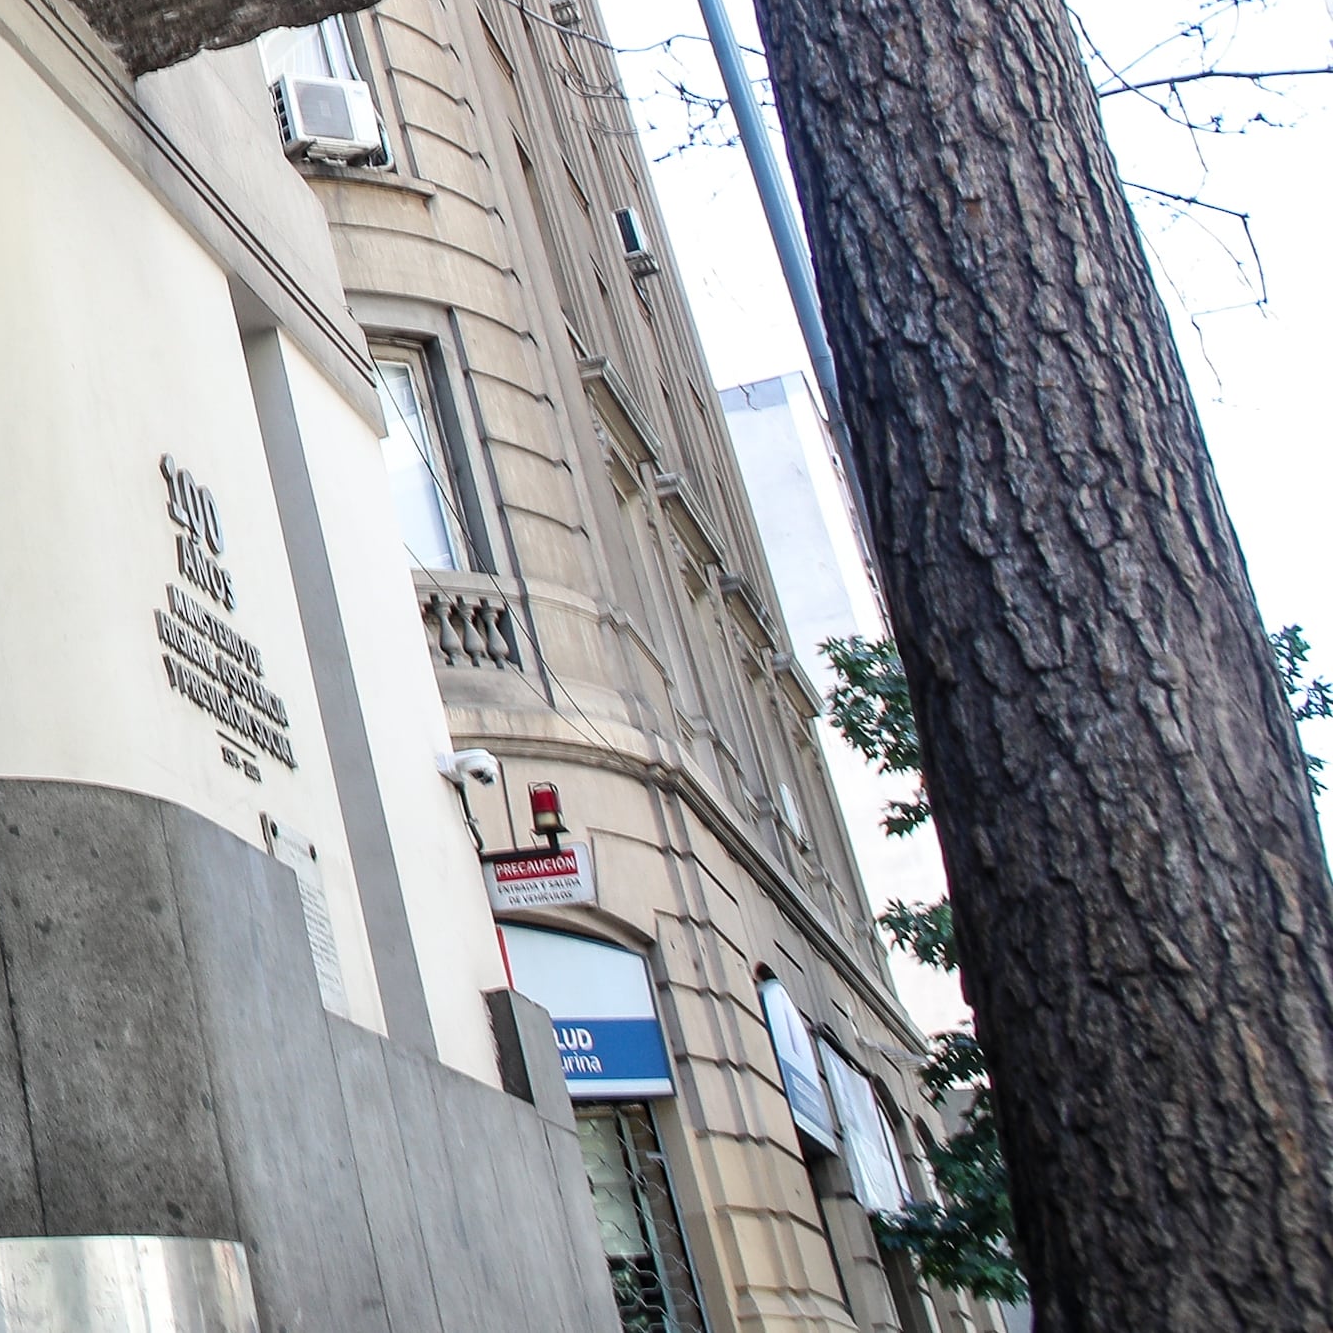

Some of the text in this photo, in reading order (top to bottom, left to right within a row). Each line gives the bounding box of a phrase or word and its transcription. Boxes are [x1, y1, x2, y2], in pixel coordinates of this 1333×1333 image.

[159, 452, 224, 555] 100
[166, 583, 264, 677] MINISTERIO DE
[162, 653, 177, 689] Y
[251, 715, 299, 770] SOCIAL
[215, 652, 290, 728] ASISTENCIA
[548, 876, 582, 888] SALIDA
[553, 1027, 593, 1051] LUD
